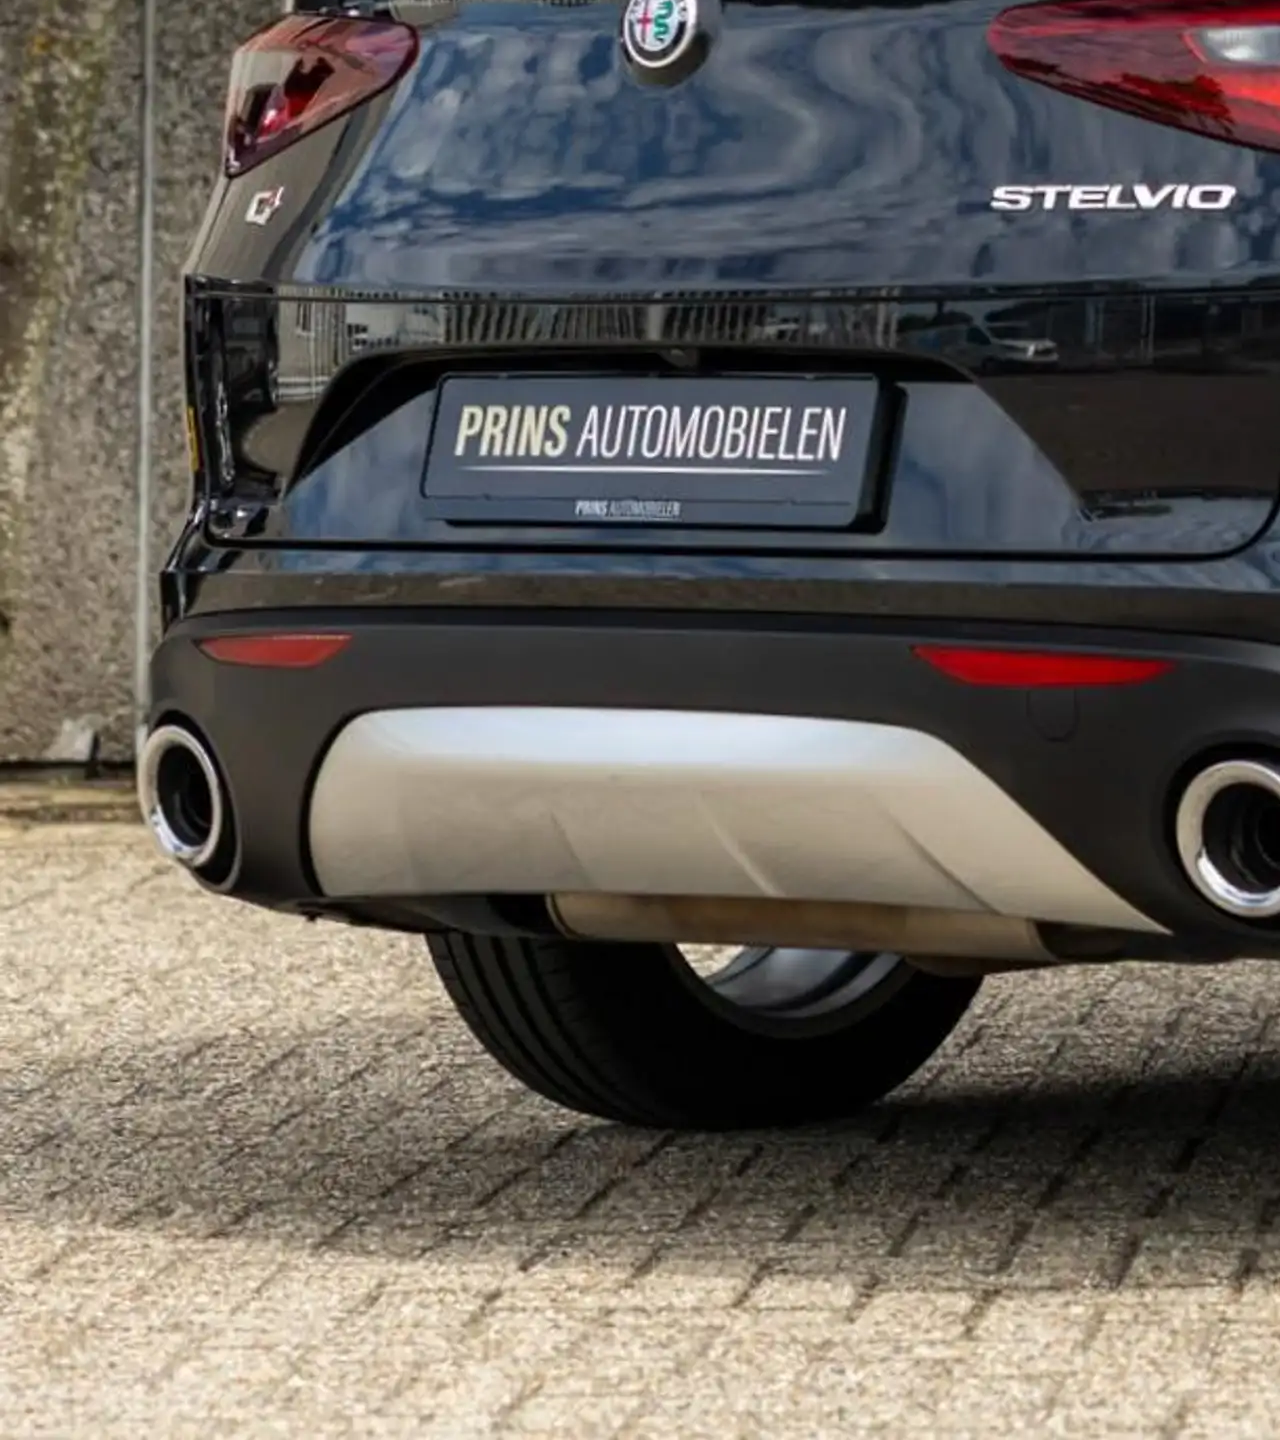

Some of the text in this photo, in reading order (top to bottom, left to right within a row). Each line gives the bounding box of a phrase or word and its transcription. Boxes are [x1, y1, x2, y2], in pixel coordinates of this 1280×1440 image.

[990, 184, 1237, 211] STELVIO
[455, 405, 847, 462] PRINS AUTOMOBIELEN
